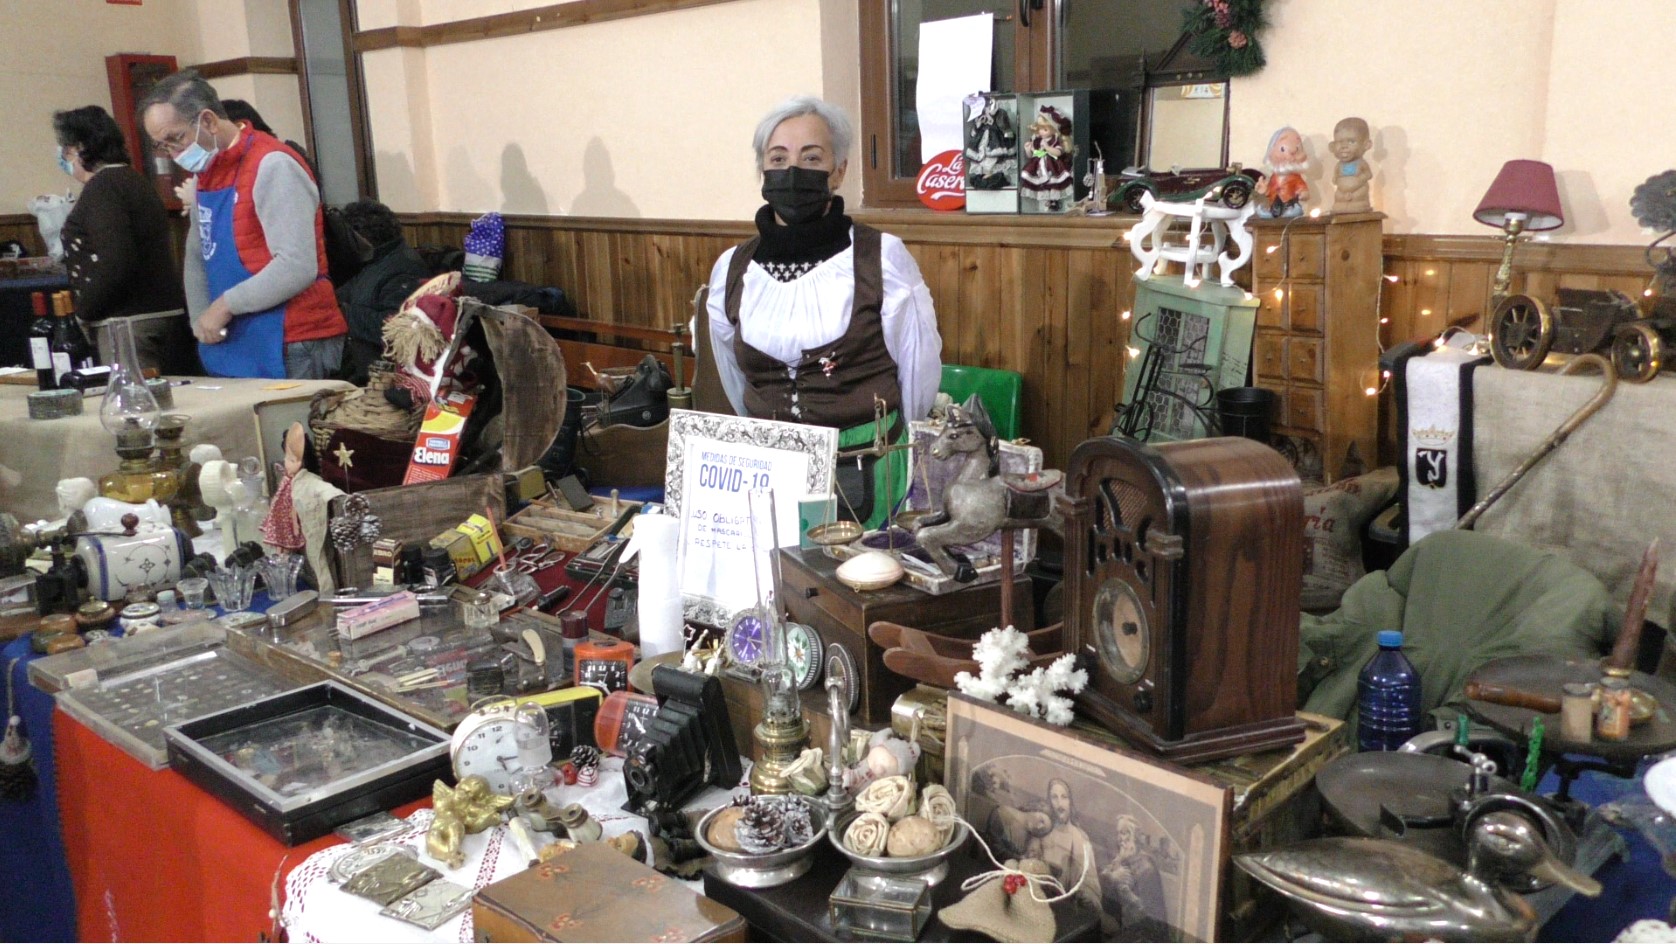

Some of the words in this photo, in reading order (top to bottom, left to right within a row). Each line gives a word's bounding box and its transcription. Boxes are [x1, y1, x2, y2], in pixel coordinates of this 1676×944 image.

[942, 153, 964, 175] La
[917, 163, 965, 194] Caser
[414, 447, 450, 465] Elena
[701, 451, 728, 464] MEDIDAS
[729, 455, 737, 466] DE
[738, 457, 772, 471] SEGURIDAD
[698, 523, 707, 532] DE
[467, 744, 479, 752] 10
